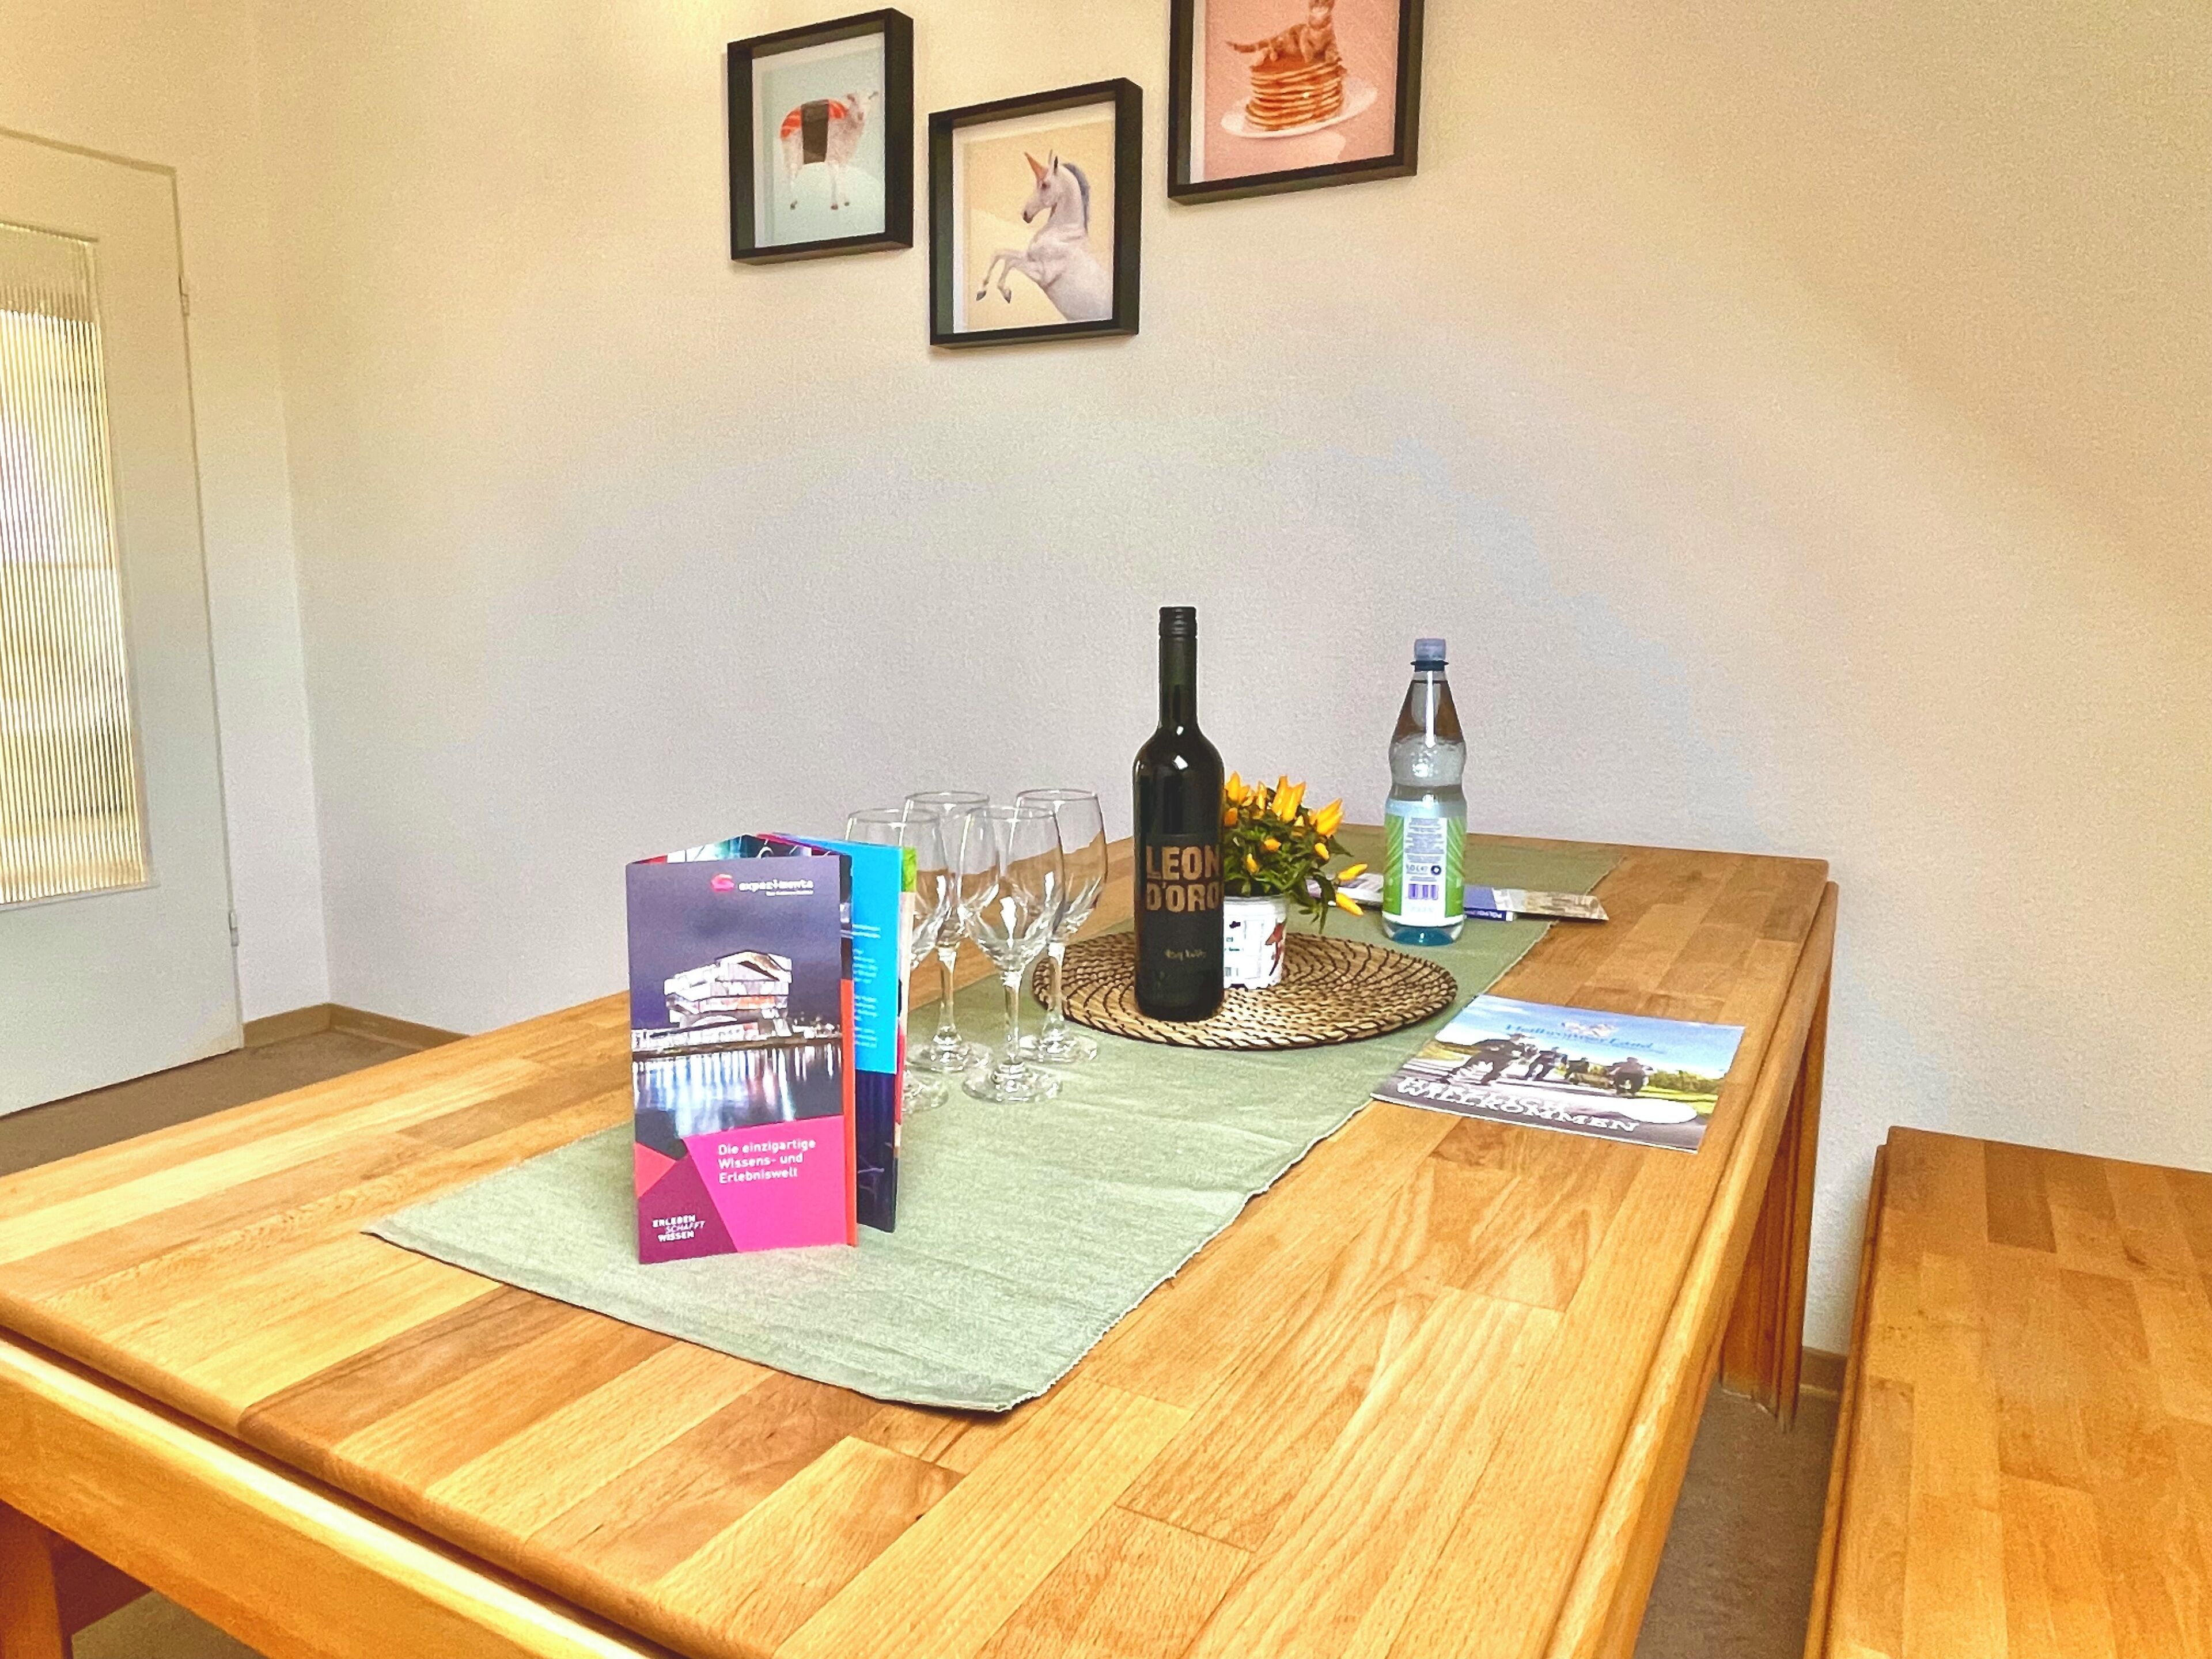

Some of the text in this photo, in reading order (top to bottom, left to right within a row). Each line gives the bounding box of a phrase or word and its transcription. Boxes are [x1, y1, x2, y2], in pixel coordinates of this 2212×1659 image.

[1146, 845, 1221, 880] LEON
[1146, 881, 1220, 912] D'ORO
[1397, 1082, 1639, 1132] WILLKOMMEN
[718, 1138, 816, 1156] Die einzigartige
[718, 1152, 804, 1169] Wissens- und
[718, 1166, 798, 1184] Erlebniswelt
[652, 1214, 696, 1228] ERLEBEN
[657, 1230, 695, 1243] WISSEN
